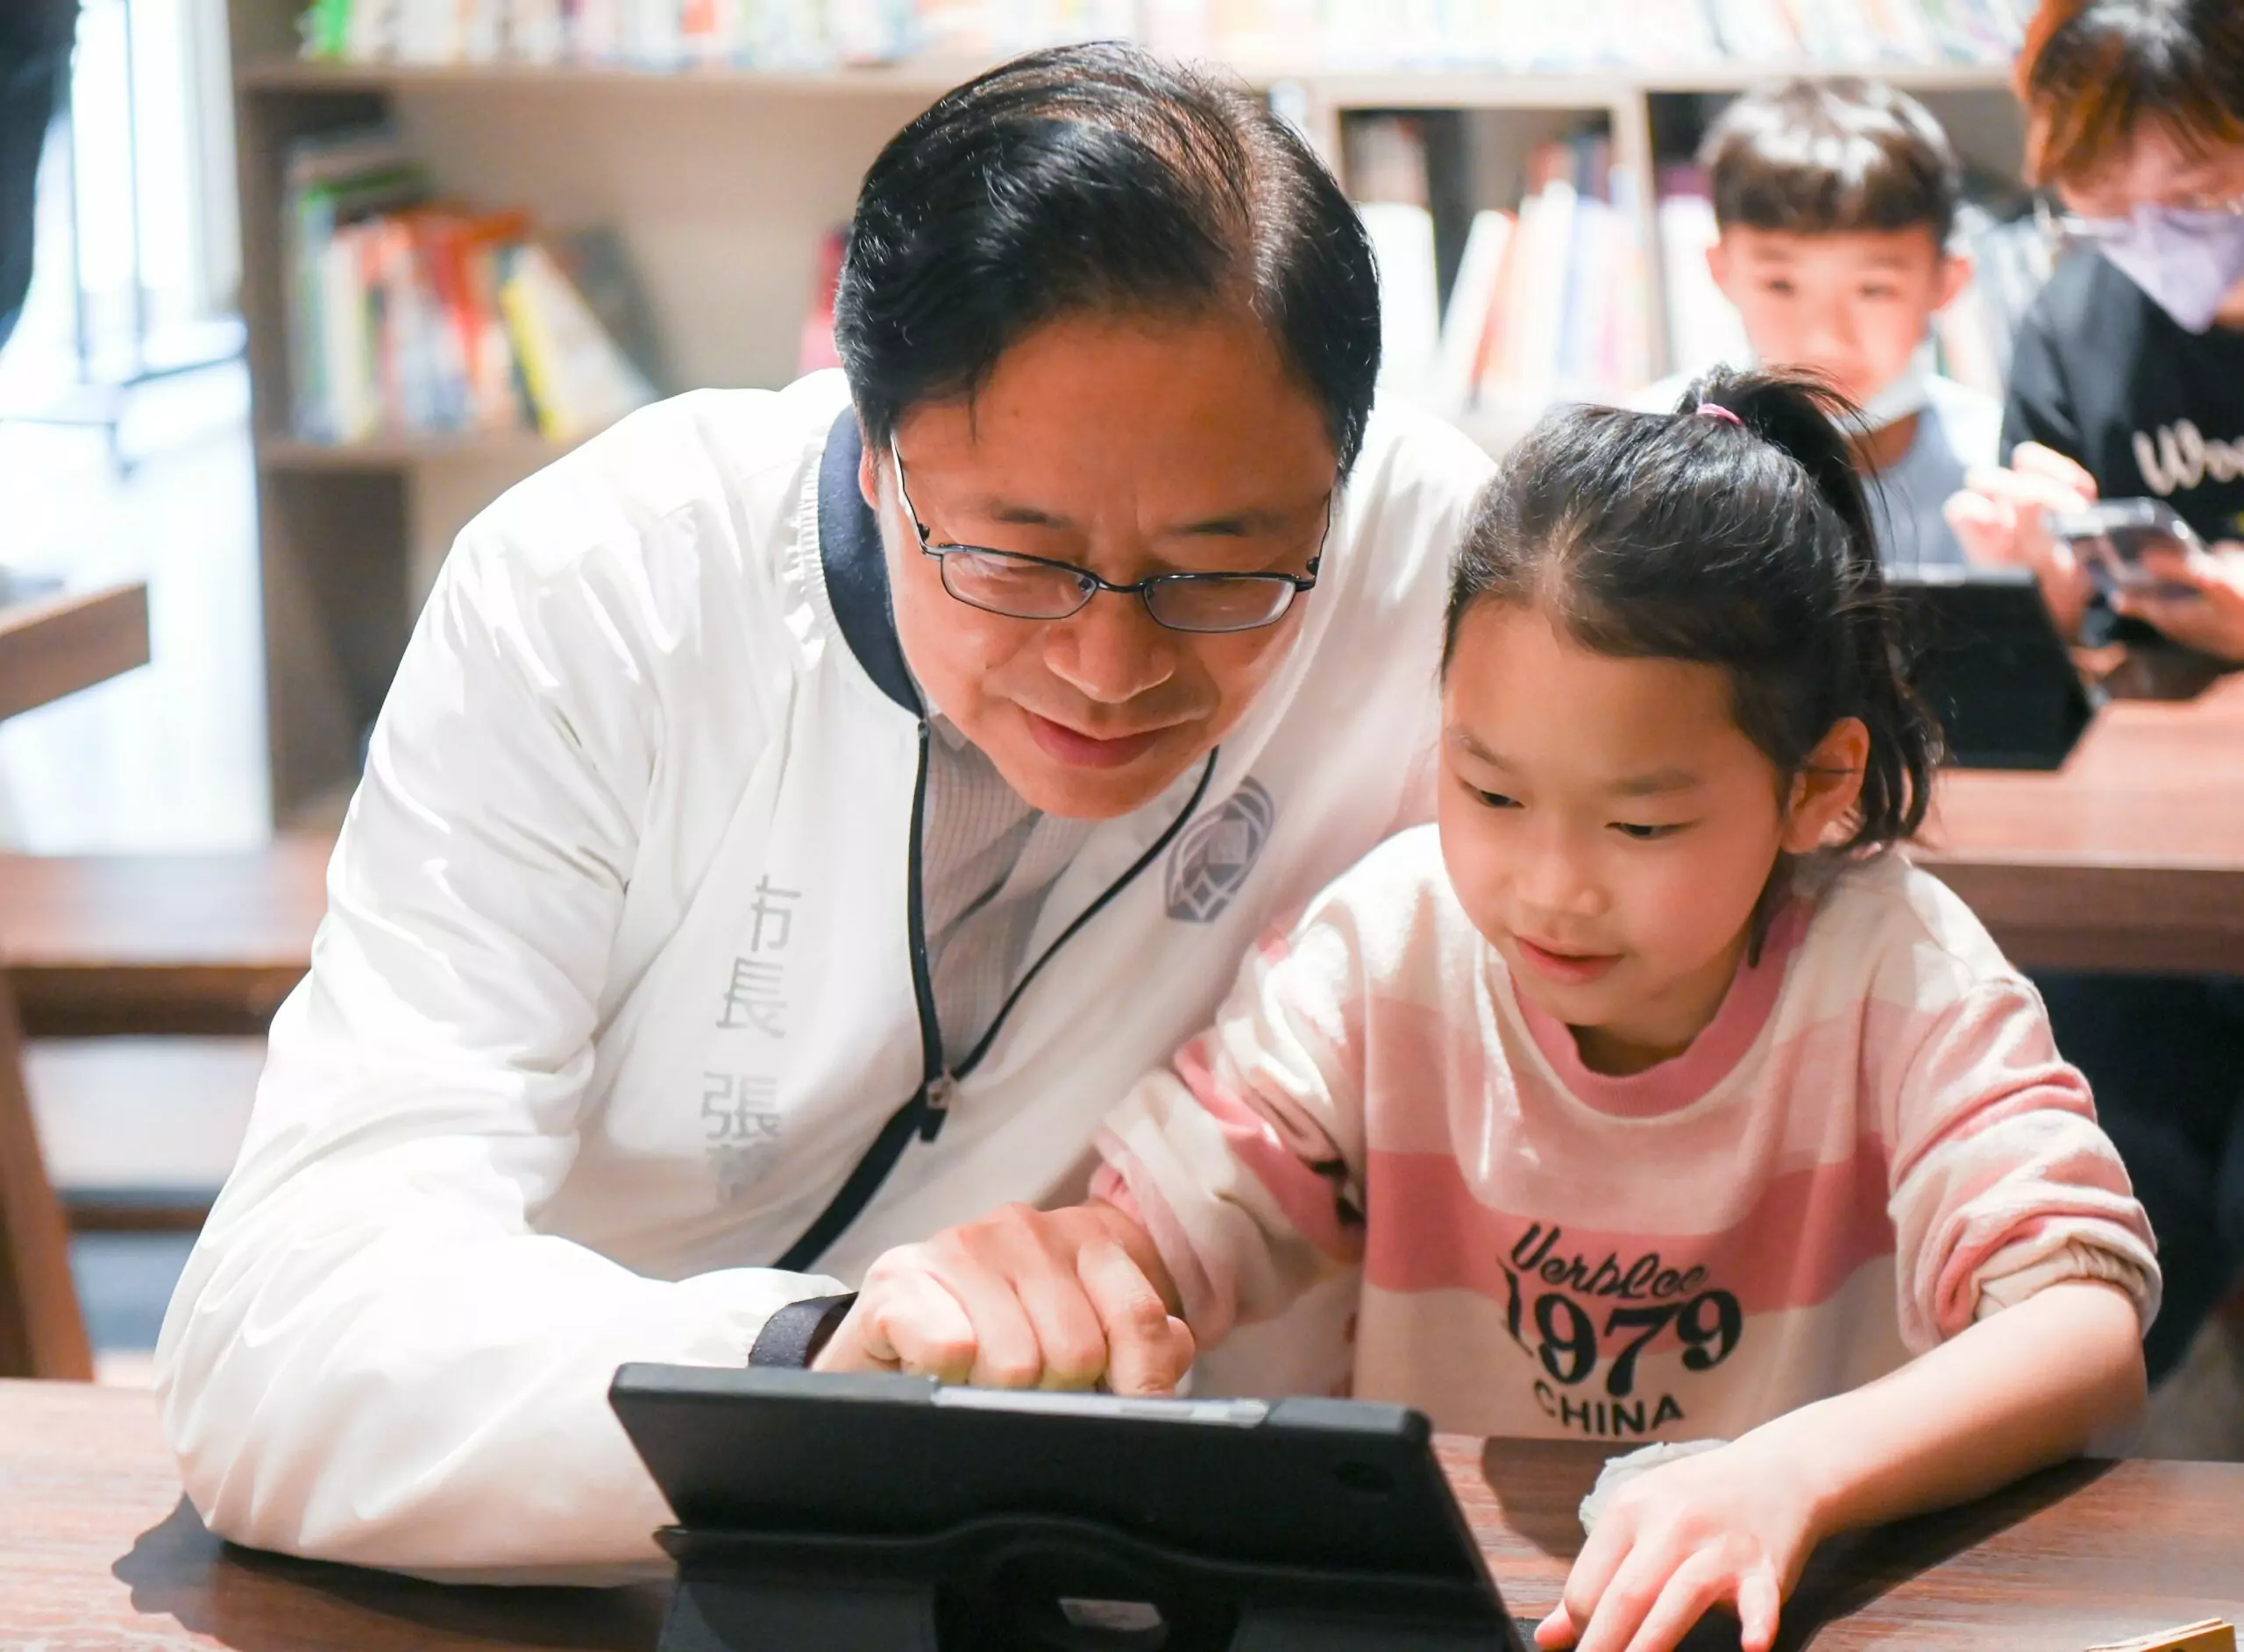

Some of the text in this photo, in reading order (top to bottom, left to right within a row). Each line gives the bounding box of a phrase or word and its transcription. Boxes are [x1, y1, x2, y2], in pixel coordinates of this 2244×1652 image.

[715, 874, 802, 1039] 市長
[1497, 1256, 1743, 1398] 1979
[1533, 1378, 1685, 1436] CHINA
